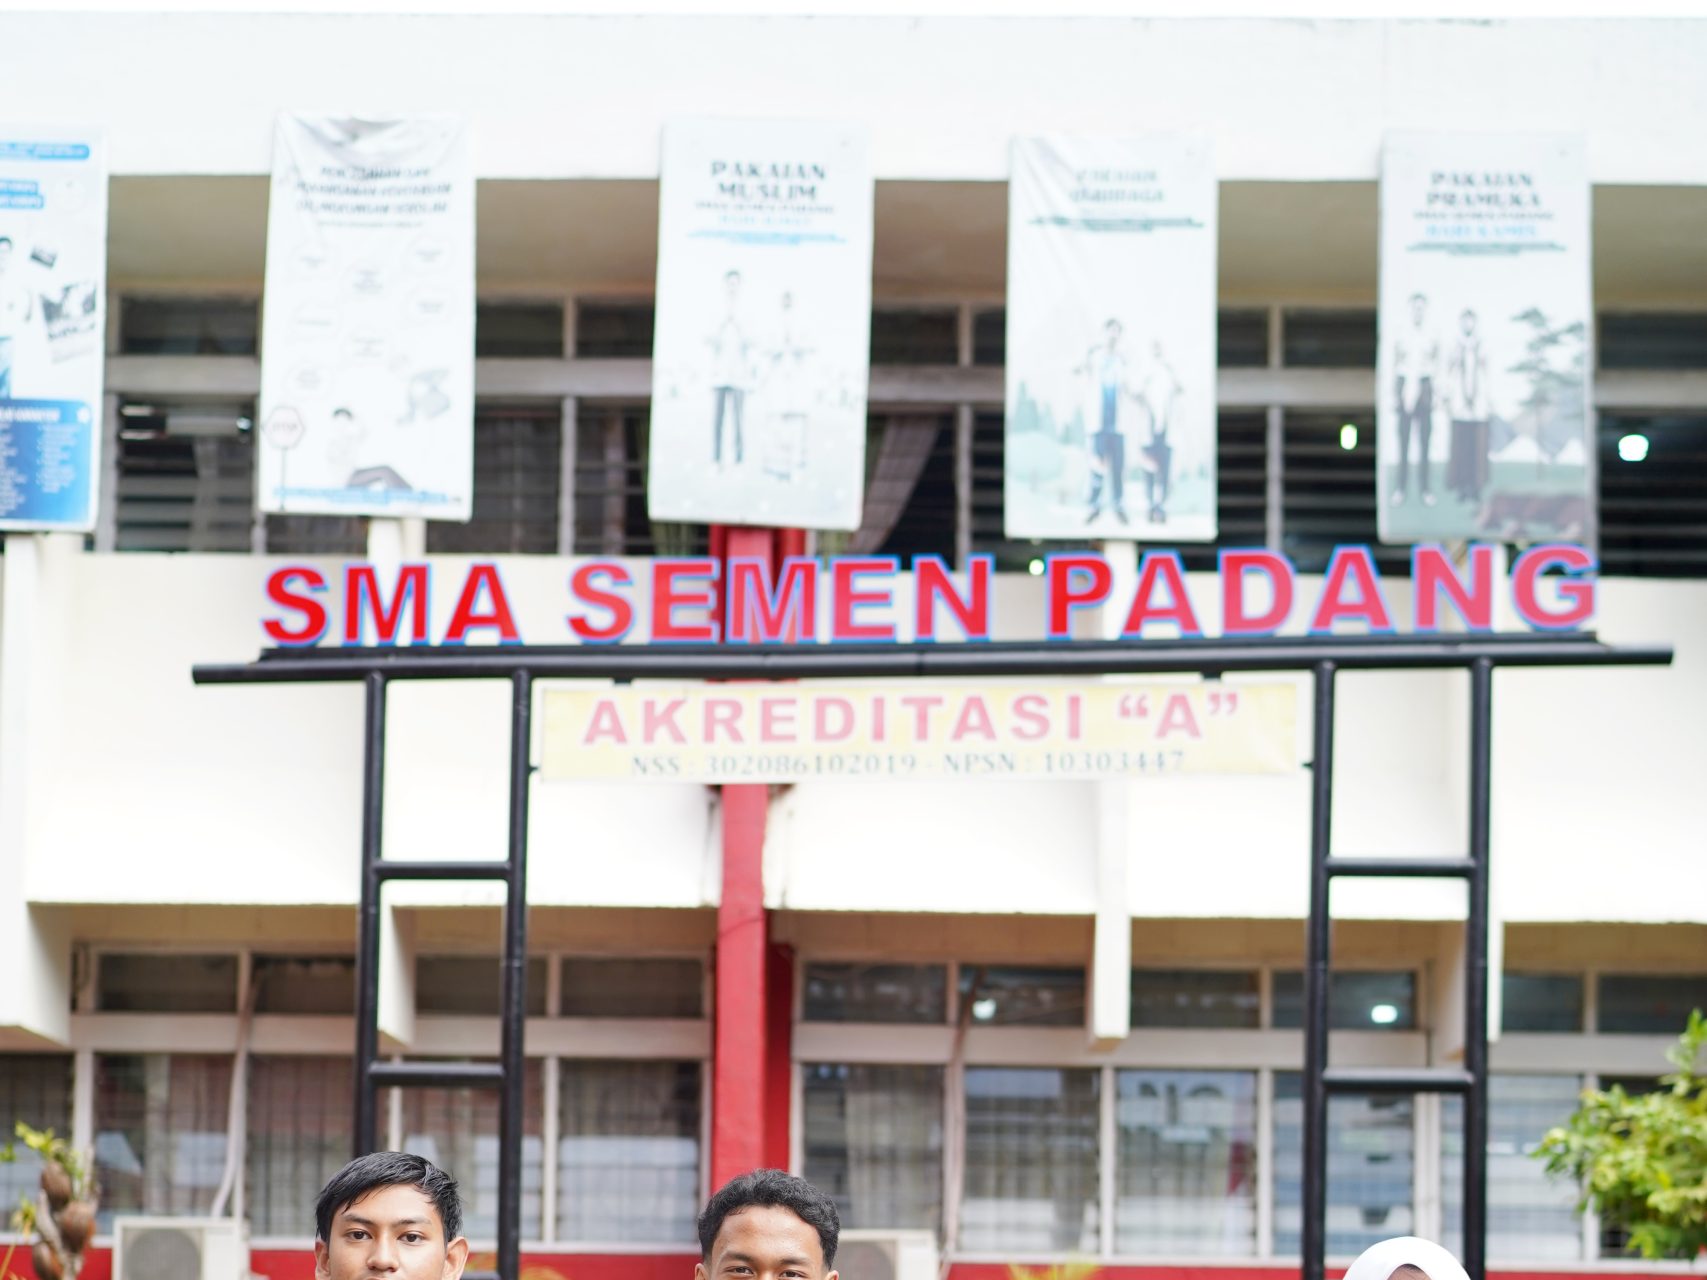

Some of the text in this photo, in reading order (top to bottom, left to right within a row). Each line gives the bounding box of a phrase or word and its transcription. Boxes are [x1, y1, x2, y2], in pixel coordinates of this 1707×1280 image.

[711, 160, 826, 180] PAKAIAN
[1431, 171, 1534, 187] PAKAIAN
[719, 182, 817, 201] MUSLIM
[261, 543, 1598, 648] SMA SEMEN PADANG
[582, 694, 1082, 746] AKREDITASI
[631, 756, 682, 777] NSS
[704, 753, 918, 777] 302086102019
[943, 752, 1016, 775] NPSN
[1043, 750, 1186, 774] 10303447
